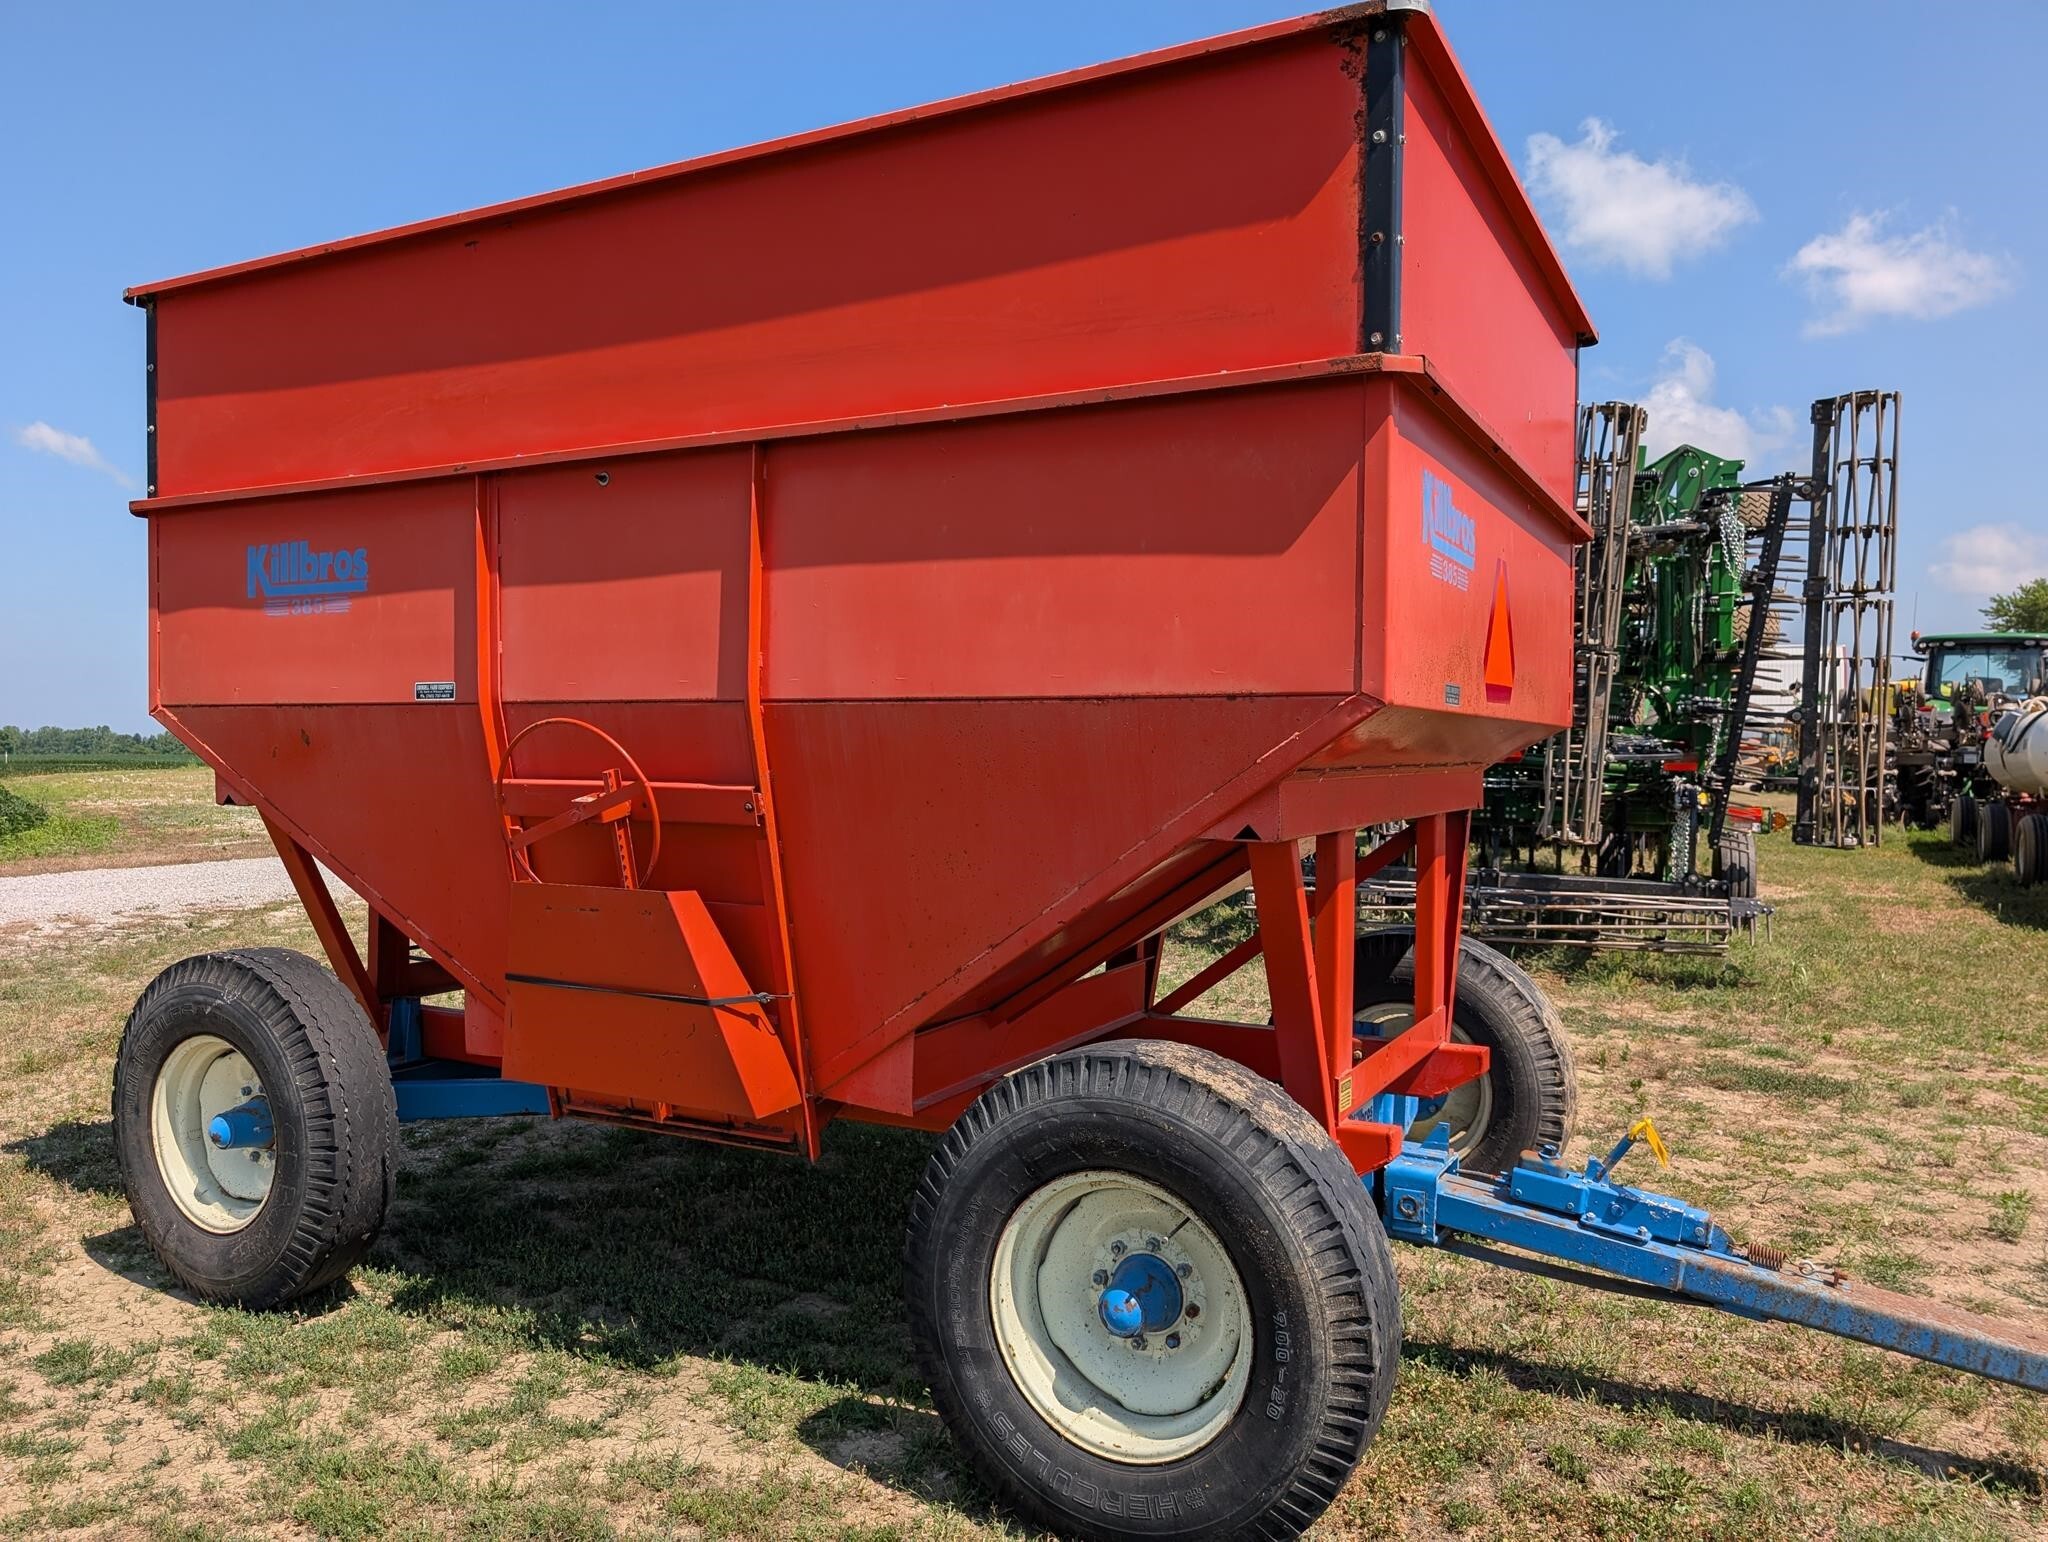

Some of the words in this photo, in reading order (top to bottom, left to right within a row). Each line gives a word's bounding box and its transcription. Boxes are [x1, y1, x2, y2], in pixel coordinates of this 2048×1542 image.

[1422, 469, 1475, 569] Killbros
[247, 541, 368, 598] Killbros
[987, 1411, 1183, 1520] HERCULES
